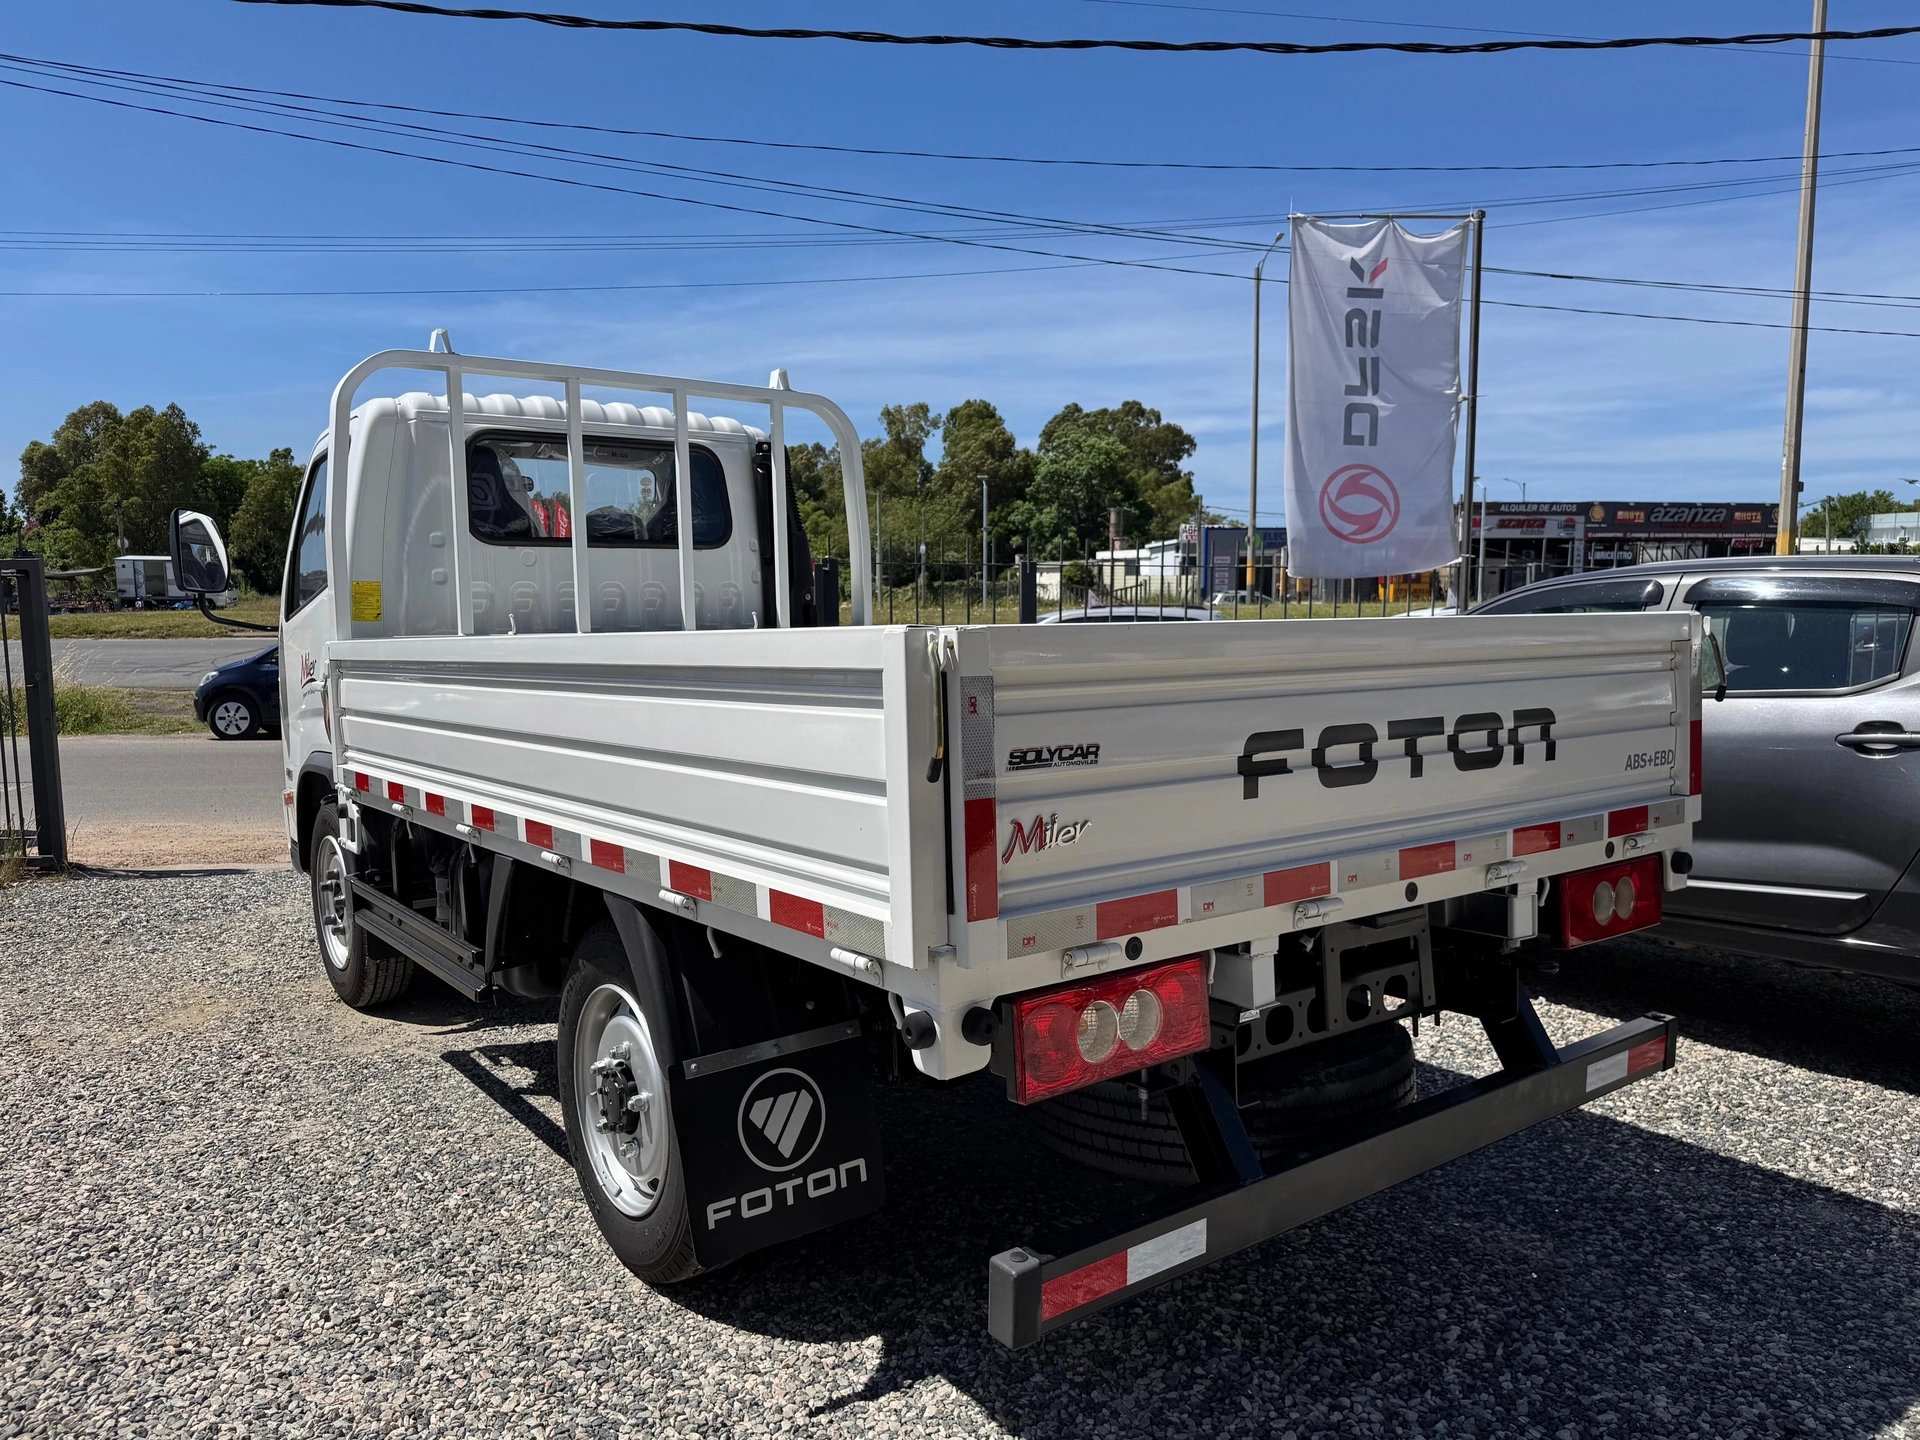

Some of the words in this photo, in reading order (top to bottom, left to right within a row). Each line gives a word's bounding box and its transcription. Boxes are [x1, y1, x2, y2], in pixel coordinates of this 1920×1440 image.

[1500, 504, 1538, 512] ALQUILER
[1539, 504, 1549, 512] DE
[1551, 504, 1577, 512] AUTOS
[1650, 506, 1727, 523] azanza
[1008, 743, 1100, 766] SOLYCAR
[1053, 759, 1099, 768] AUTOMOVILES
[1237, 707, 1557, 801] FOTON
[1624, 749, 1675, 771] ABS+EBD
[706, 1157, 868, 1231] FOTON
